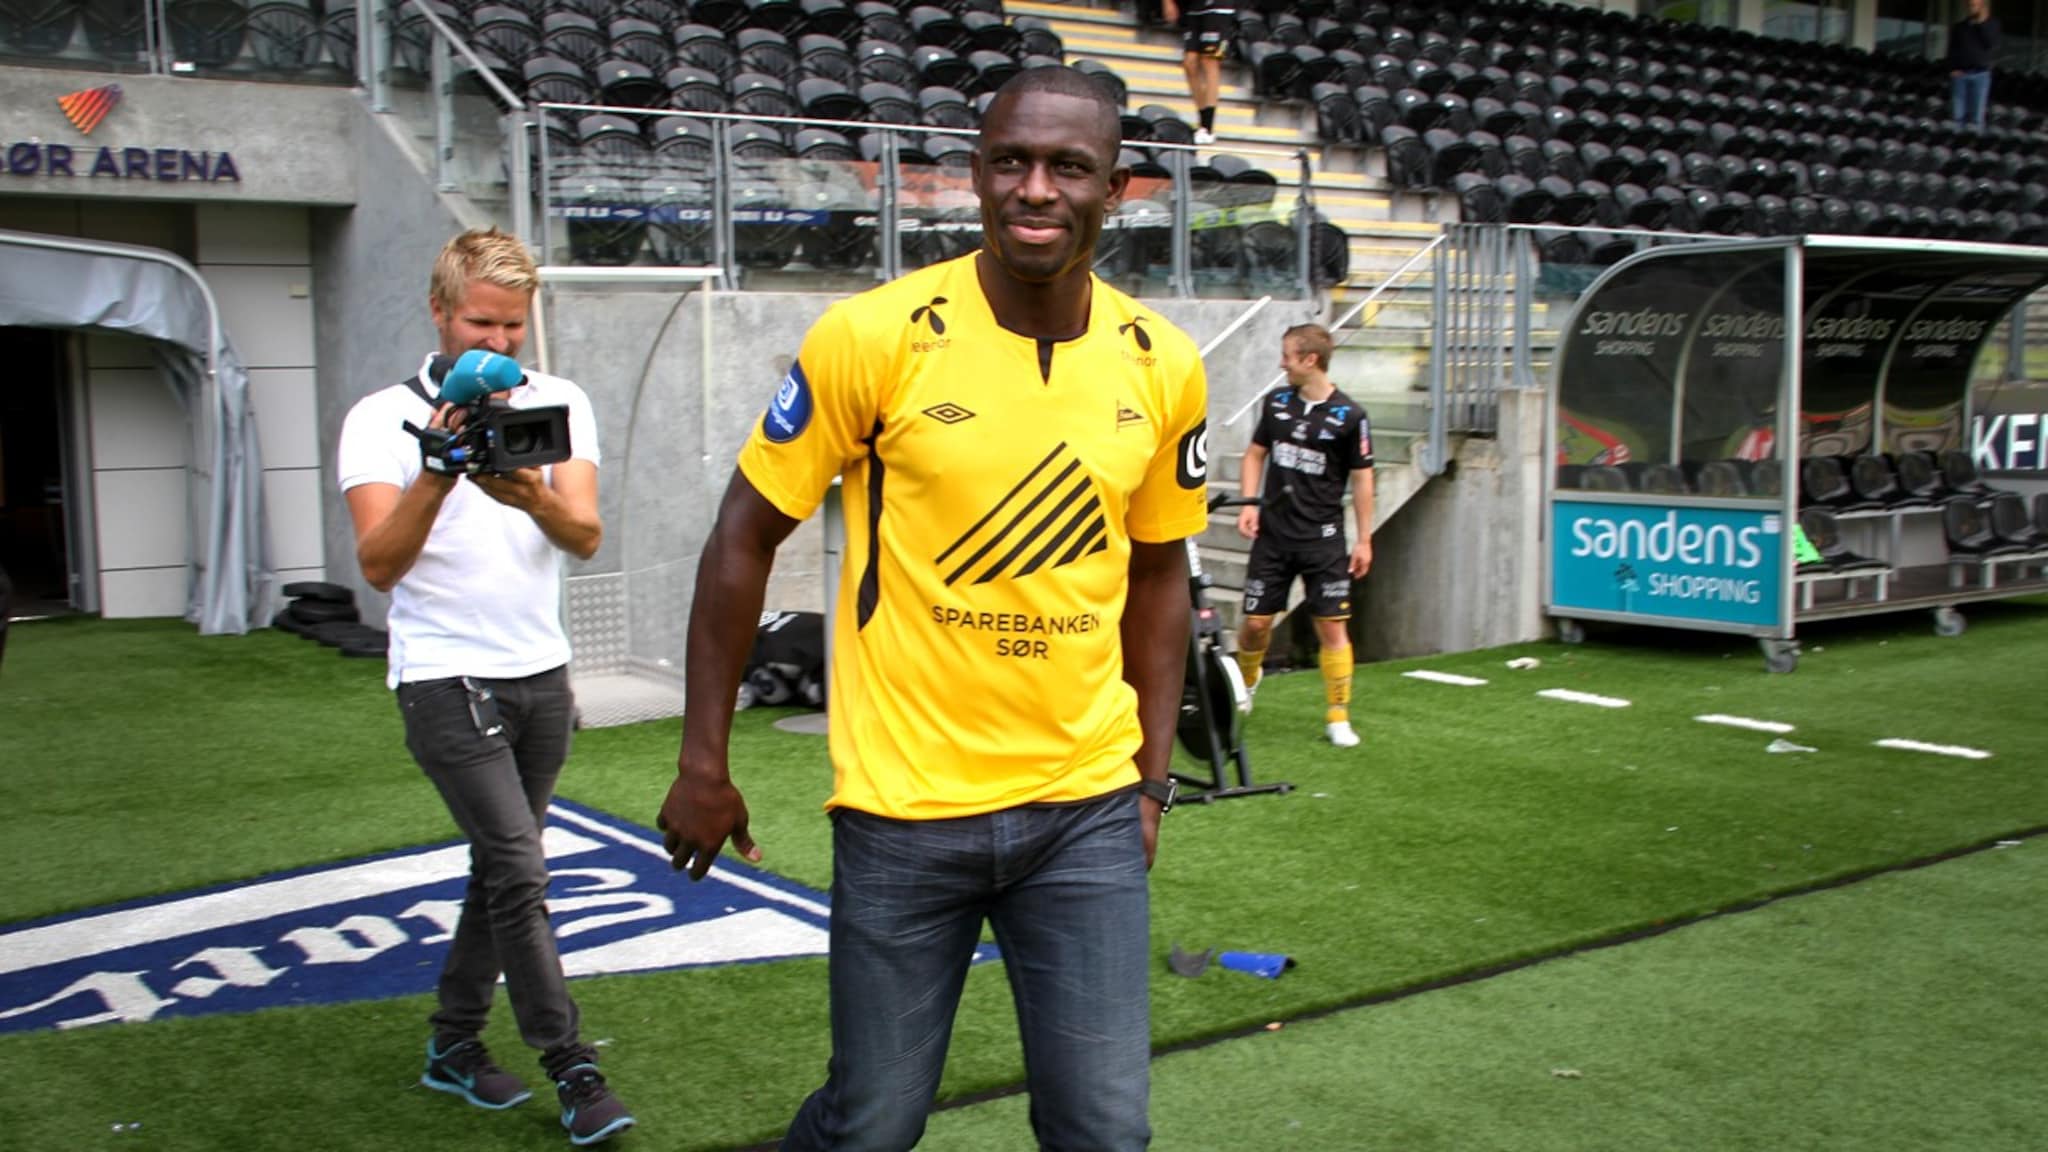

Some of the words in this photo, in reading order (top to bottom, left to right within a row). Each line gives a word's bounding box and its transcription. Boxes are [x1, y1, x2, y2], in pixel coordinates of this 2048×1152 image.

[91, 146, 241, 182] ARENA
[1580, 306, 1688, 337] sandens
[1701, 311, 1785, 339] sanden
[1807, 314, 1896, 340] sandens
[1904, 315, 1987, 341] sandens
[1594, 340, 1656, 356] SHOPPING
[1571, 510, 1762, 569] sandens
[1648, 573, 1761, 604] SHOPPING
[932, 606, 1101, 635] SPAREBANKEN
[996, 638, 1049, 660] SØR
